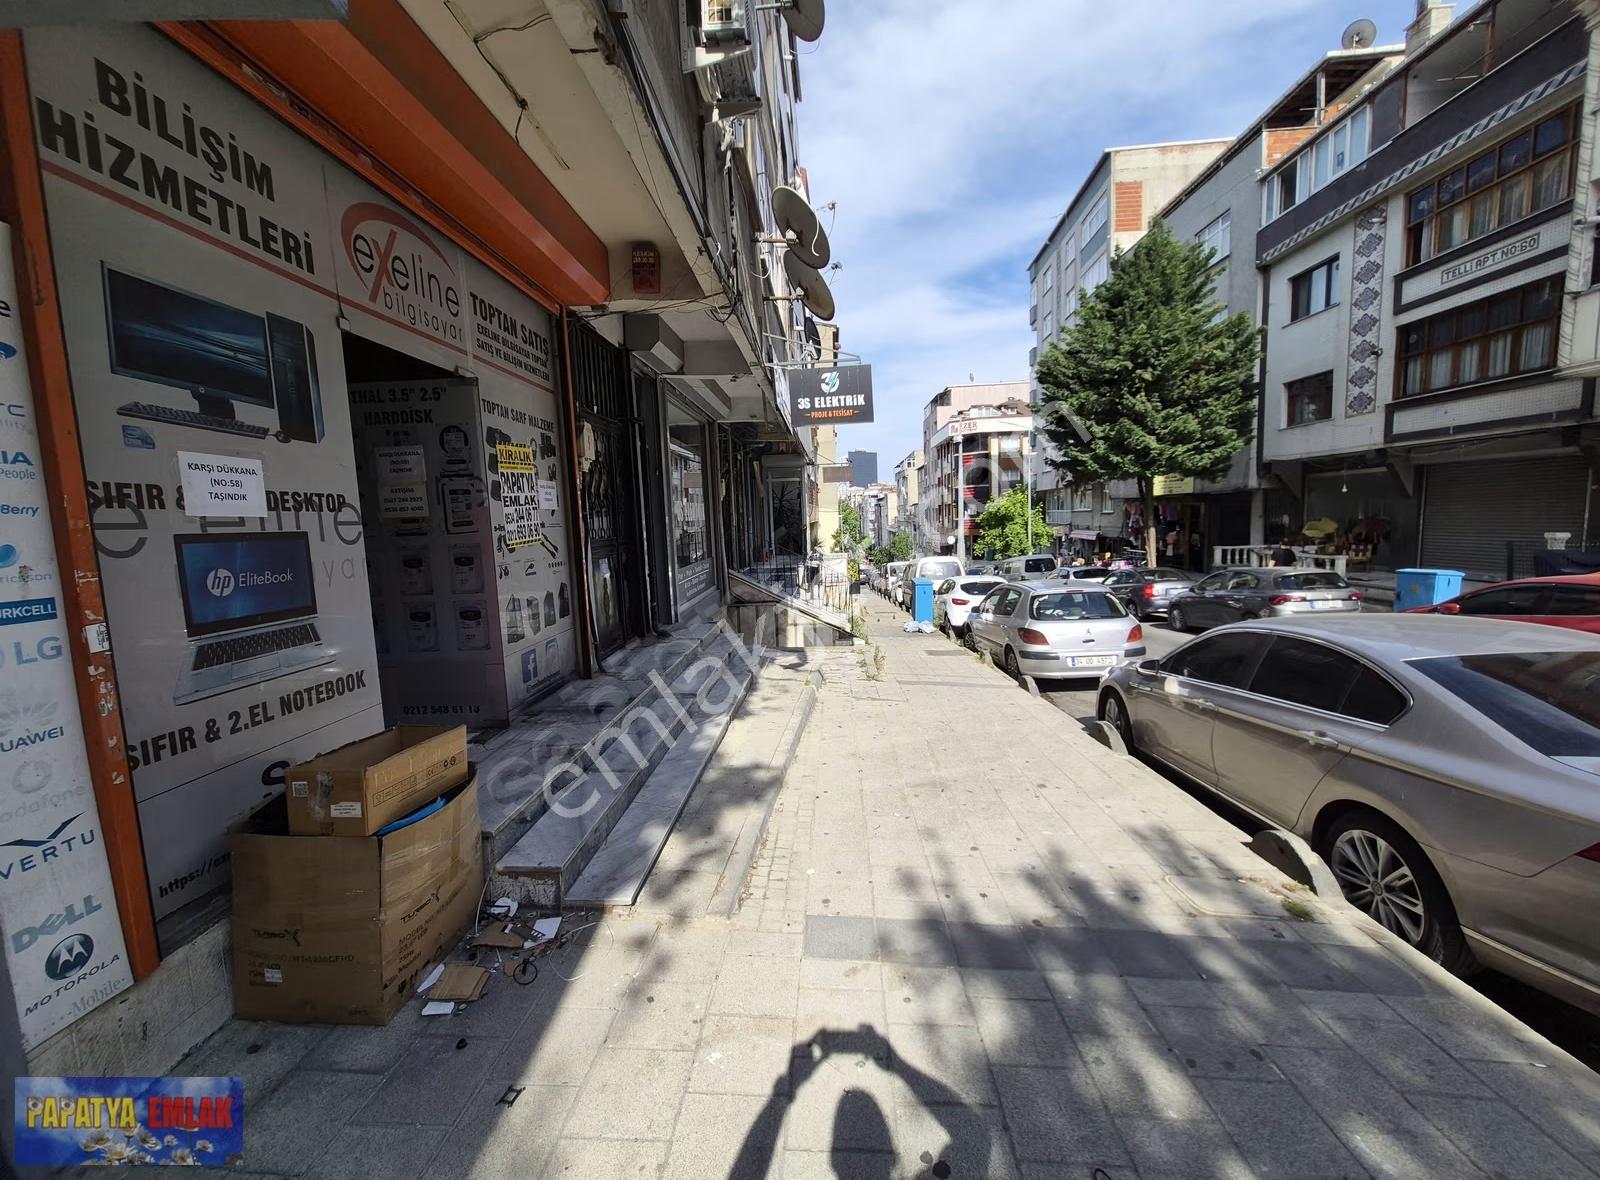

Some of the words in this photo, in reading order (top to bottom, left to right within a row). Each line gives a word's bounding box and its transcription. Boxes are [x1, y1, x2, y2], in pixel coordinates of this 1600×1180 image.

[94, 57, 276, 203] BİLİŞİM
[36, 96, 315, 276] HİZMETLERİ
[383, 286, 463, 343] bilgisayar
[469, 290, 518, 340] TOPTAN
[519, 324, 549, 362] SATIŞ
[476, 337, 494, 358] SATIŞ
[495, 346, 502, 360] VE
[797, 398, 811, 409] 3S
[814, 393, 865, 409] ELEKTRİK
[810, 410, 827, 419] PROJE
[833, 408, 853, 417] TESİSAT
[481, 399, 510, 420] TOPTAN
[510, 408, 528, 424] SARF
[528, 415, 555, 434] MALZEME
[499, 446, 532, 462] KİRALIK
[187, 462, 215, 474] KARŞI
[216, 464, 258, 477] DÜKKANA
[500, 472, 535, 494] PAPATYA
[86, 481, 167, 510] SIFIR
[266, 491, 347, 513] DESKTOP
[208, 491, 248, 502] TAŞINDIK
[210, 478, 243, 490] (NO:58)
[503, 495, 538, 508] EMLAK
[515, 508, 525, 524] 244
[239, 568, 294, 588] EliteBook
[14, 635, 64, 666] LG
[126, 726, 198, 772] SIFIR
[204, 718, 222, 744] &
[228, 701, 275, 736] 2.EL
[279, 670, 367, 718] NOTEBOOK
[0, 829, 96, 881] VERTU
[11, 894, 103, 955] DELL
[24, 953, 121, 1018] MOTOROLA
